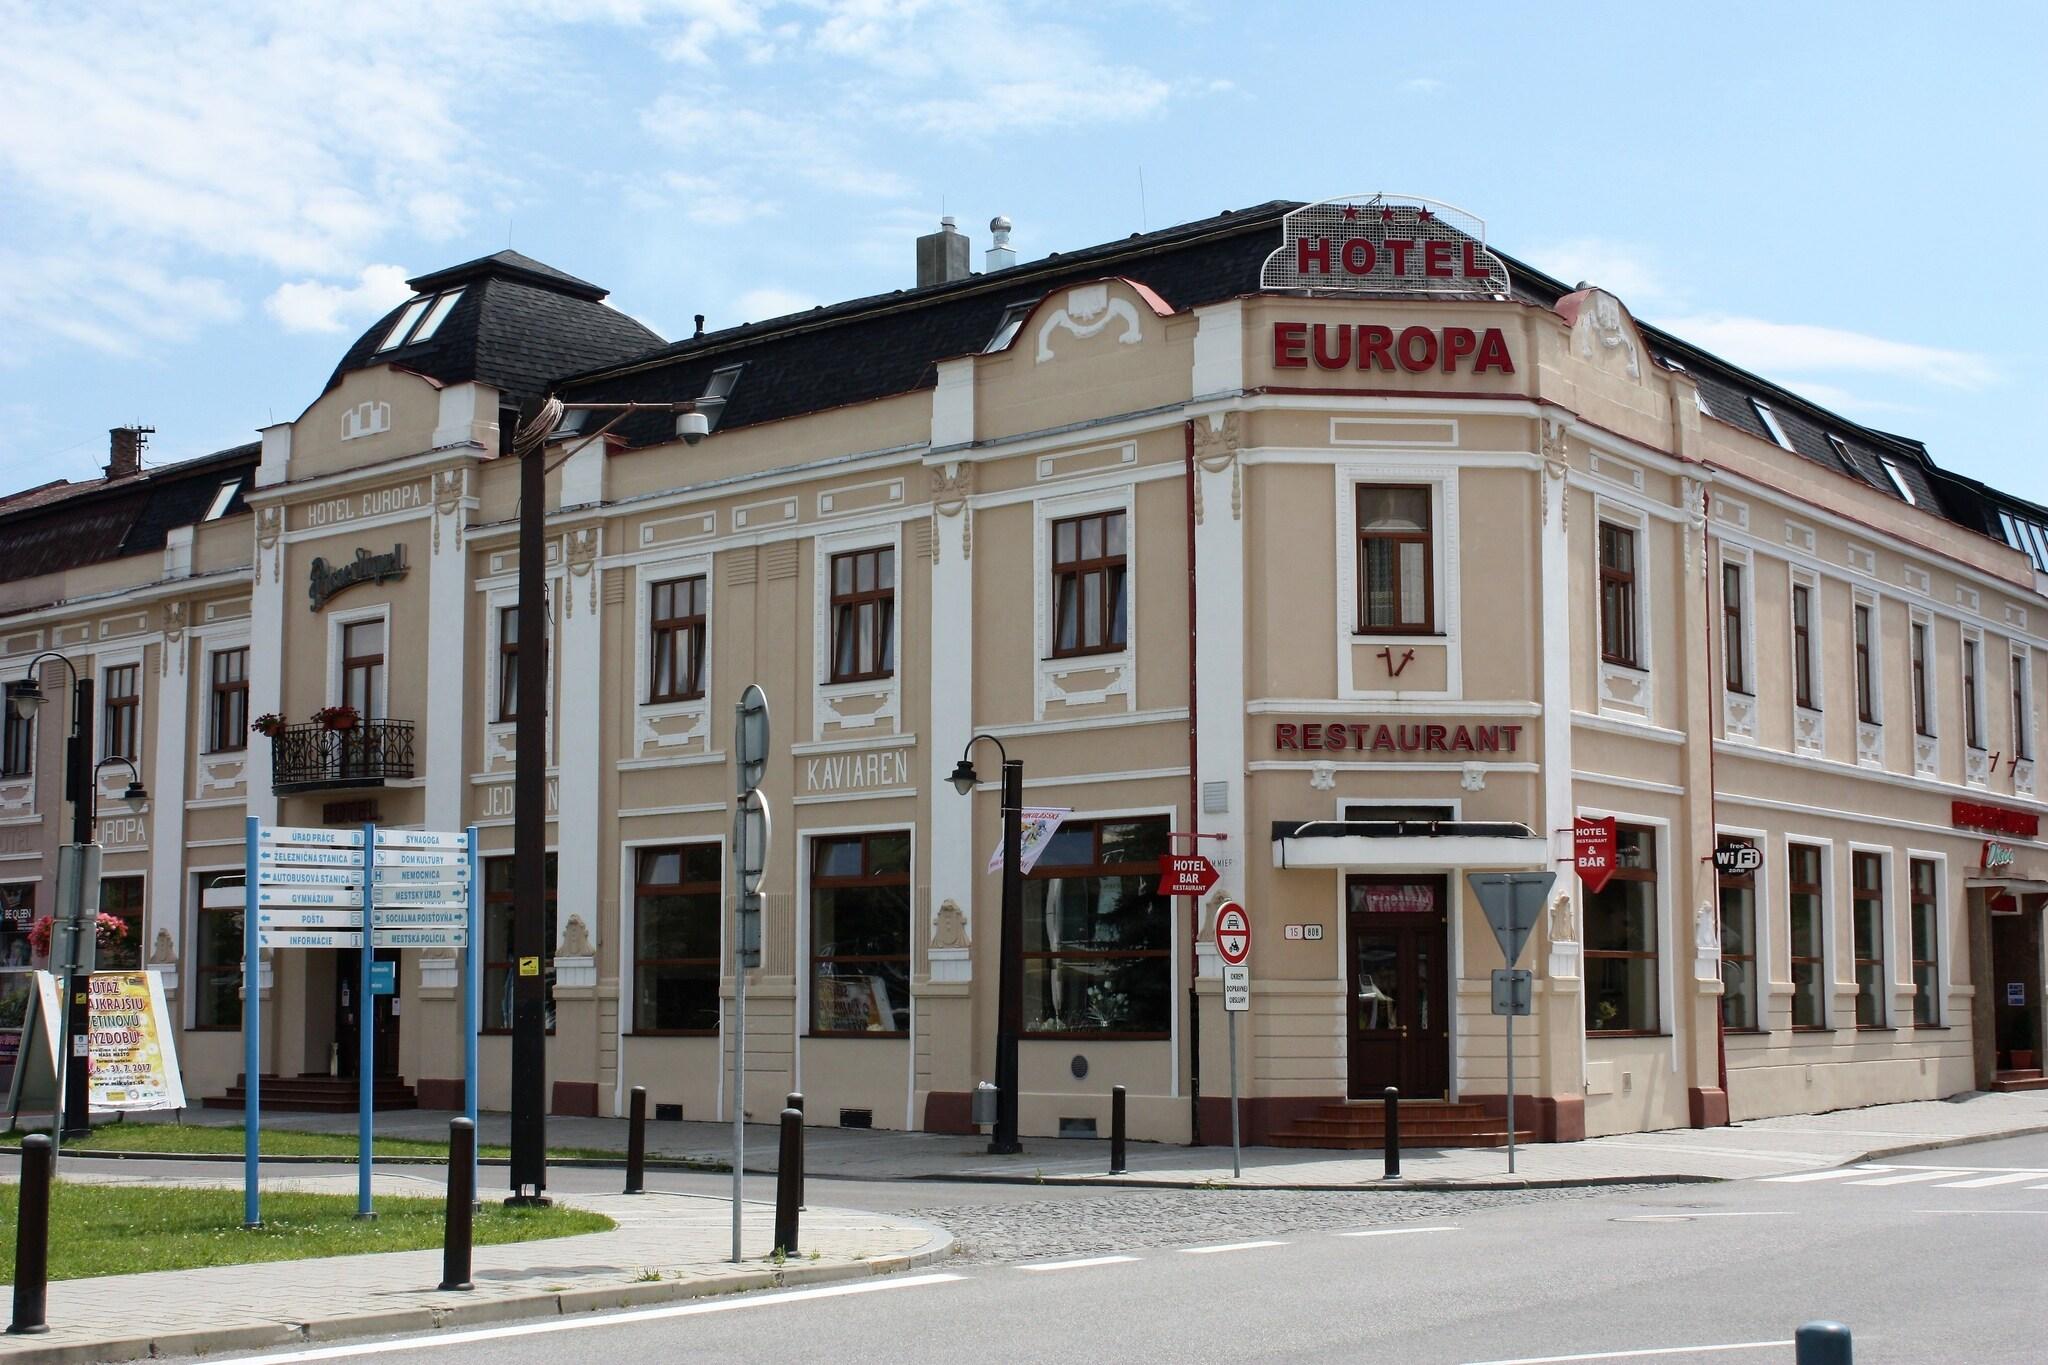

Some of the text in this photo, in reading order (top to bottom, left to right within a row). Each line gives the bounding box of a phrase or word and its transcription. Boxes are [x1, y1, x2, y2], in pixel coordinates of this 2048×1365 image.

[1297, 237, 1490, 279] HOTEL
[1273, 322, 1516, 374] EUROPA
[308, 484, 421, 526] HOTEL EUROPA
[1276, 723, 1522, 752] RESTAURANT
[95, 817, 146, 844] UROPA
[1576, 828, 1608, 836] HOTEL
[1588, 846, 1597, 855] &
[319, 854, 348, 863] STANICA
[401, 855, 415, 864] DOM
[1578, 857, 1606, 868] BAR
[1173, 860, 1206, 872] HOTEL
[320, 874, 349, 884] STANICA
[401, 870, 440, 881] NEMOCNICA
[1179, 873, 1199, 883] BAR
[1290, 927, 1299, 937] 15
[132, 1063, 150, 1071] 2017
